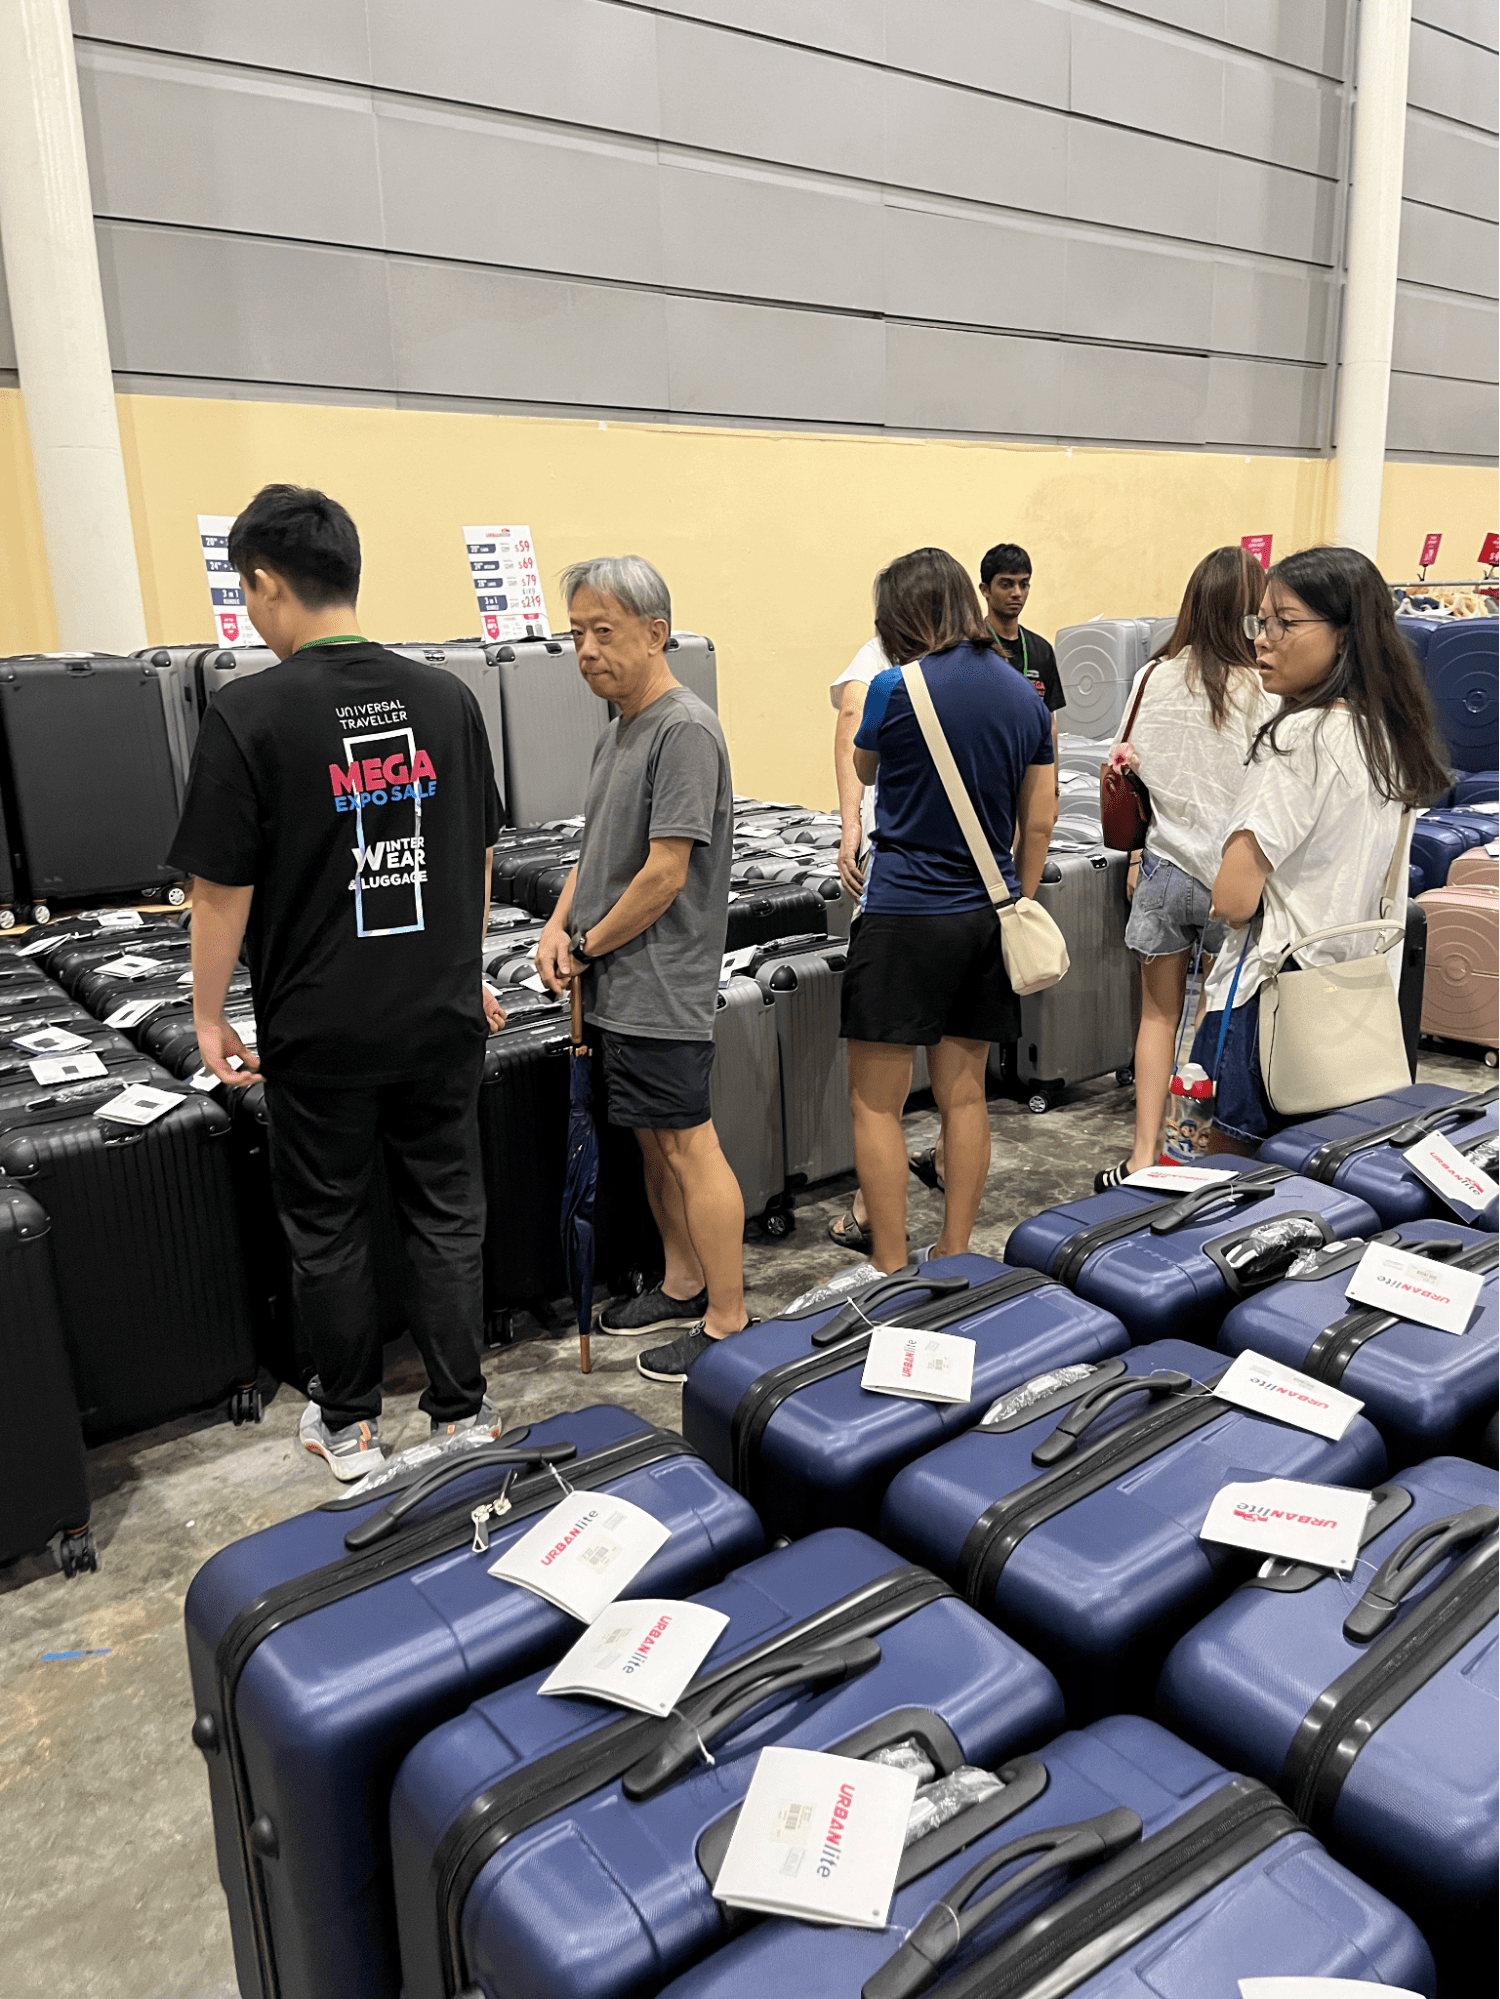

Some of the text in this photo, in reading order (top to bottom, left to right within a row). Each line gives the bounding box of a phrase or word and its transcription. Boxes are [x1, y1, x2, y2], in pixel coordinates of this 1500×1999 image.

[515, 540, 530, 552] $59
[518, 557, 533, 569] $69
[521, 574, 537, 587] $79
[339, 711, 408, 730] TRAVELLER
[328, 749, 437, 796] MEGA
[334, 780, 437, 812] EXPO SALE
[360, 870, 428, 890] LUGGAGE
[1236, 1502, 1338, 1529] URBANlite
[540, 1509, 599, 1566] URBANlite
[622, 1615, 673, 1674] URBANlite
[816, 1783, 855, 1878] URBANlite
